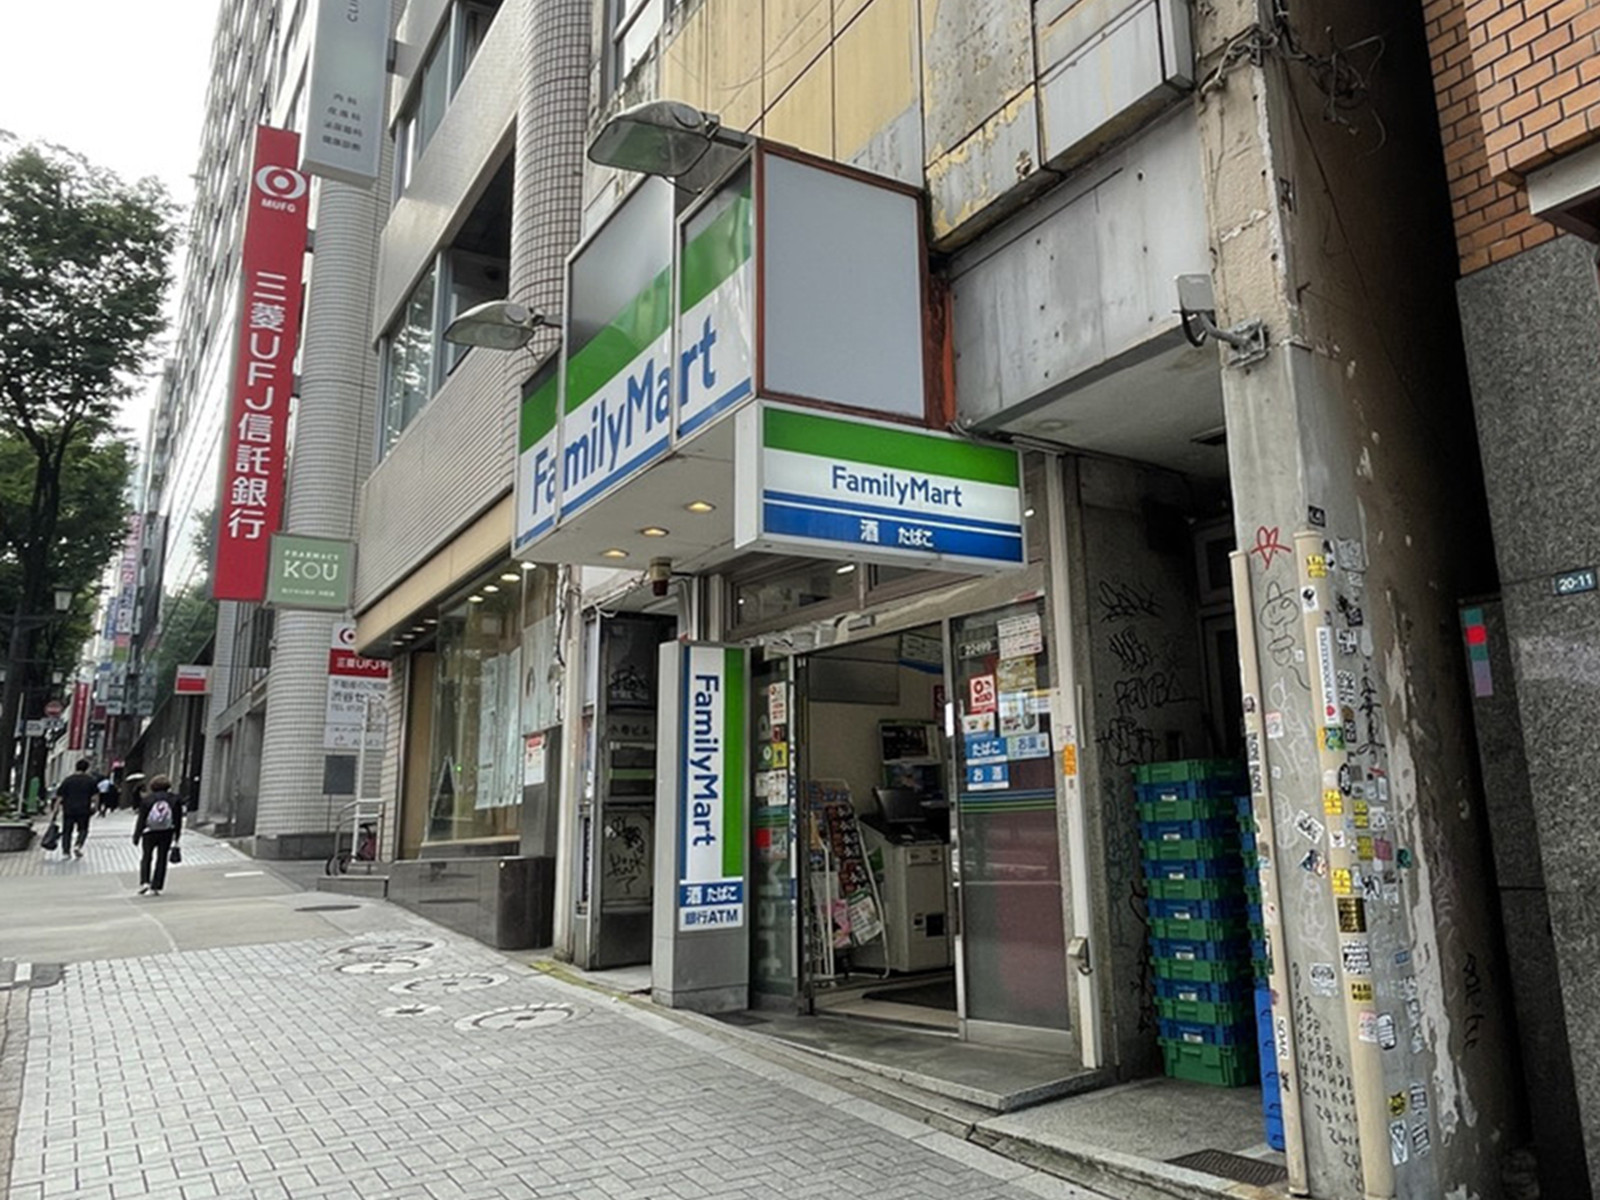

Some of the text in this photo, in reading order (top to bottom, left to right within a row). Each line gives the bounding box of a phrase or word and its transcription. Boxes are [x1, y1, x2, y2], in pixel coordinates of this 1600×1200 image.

[346, 0, 359, 23] CLI
[261, 198, 296, 213] MUFG
[228, 271, 287, 540] 三菱UFJ信託銀行
[832, 465, 962, 507] FamilyMart
[860, 519, 934, 547] 酒 たばこ
[283, 560, 339, 581] KOU
[1559, 573, 1592, 590] 20-11
[690, 674, 719, 847] FamilyMart
[685, 884, 738, 904] 酒 たばこ
[684, 908, 738, 926] 銀行ATM
